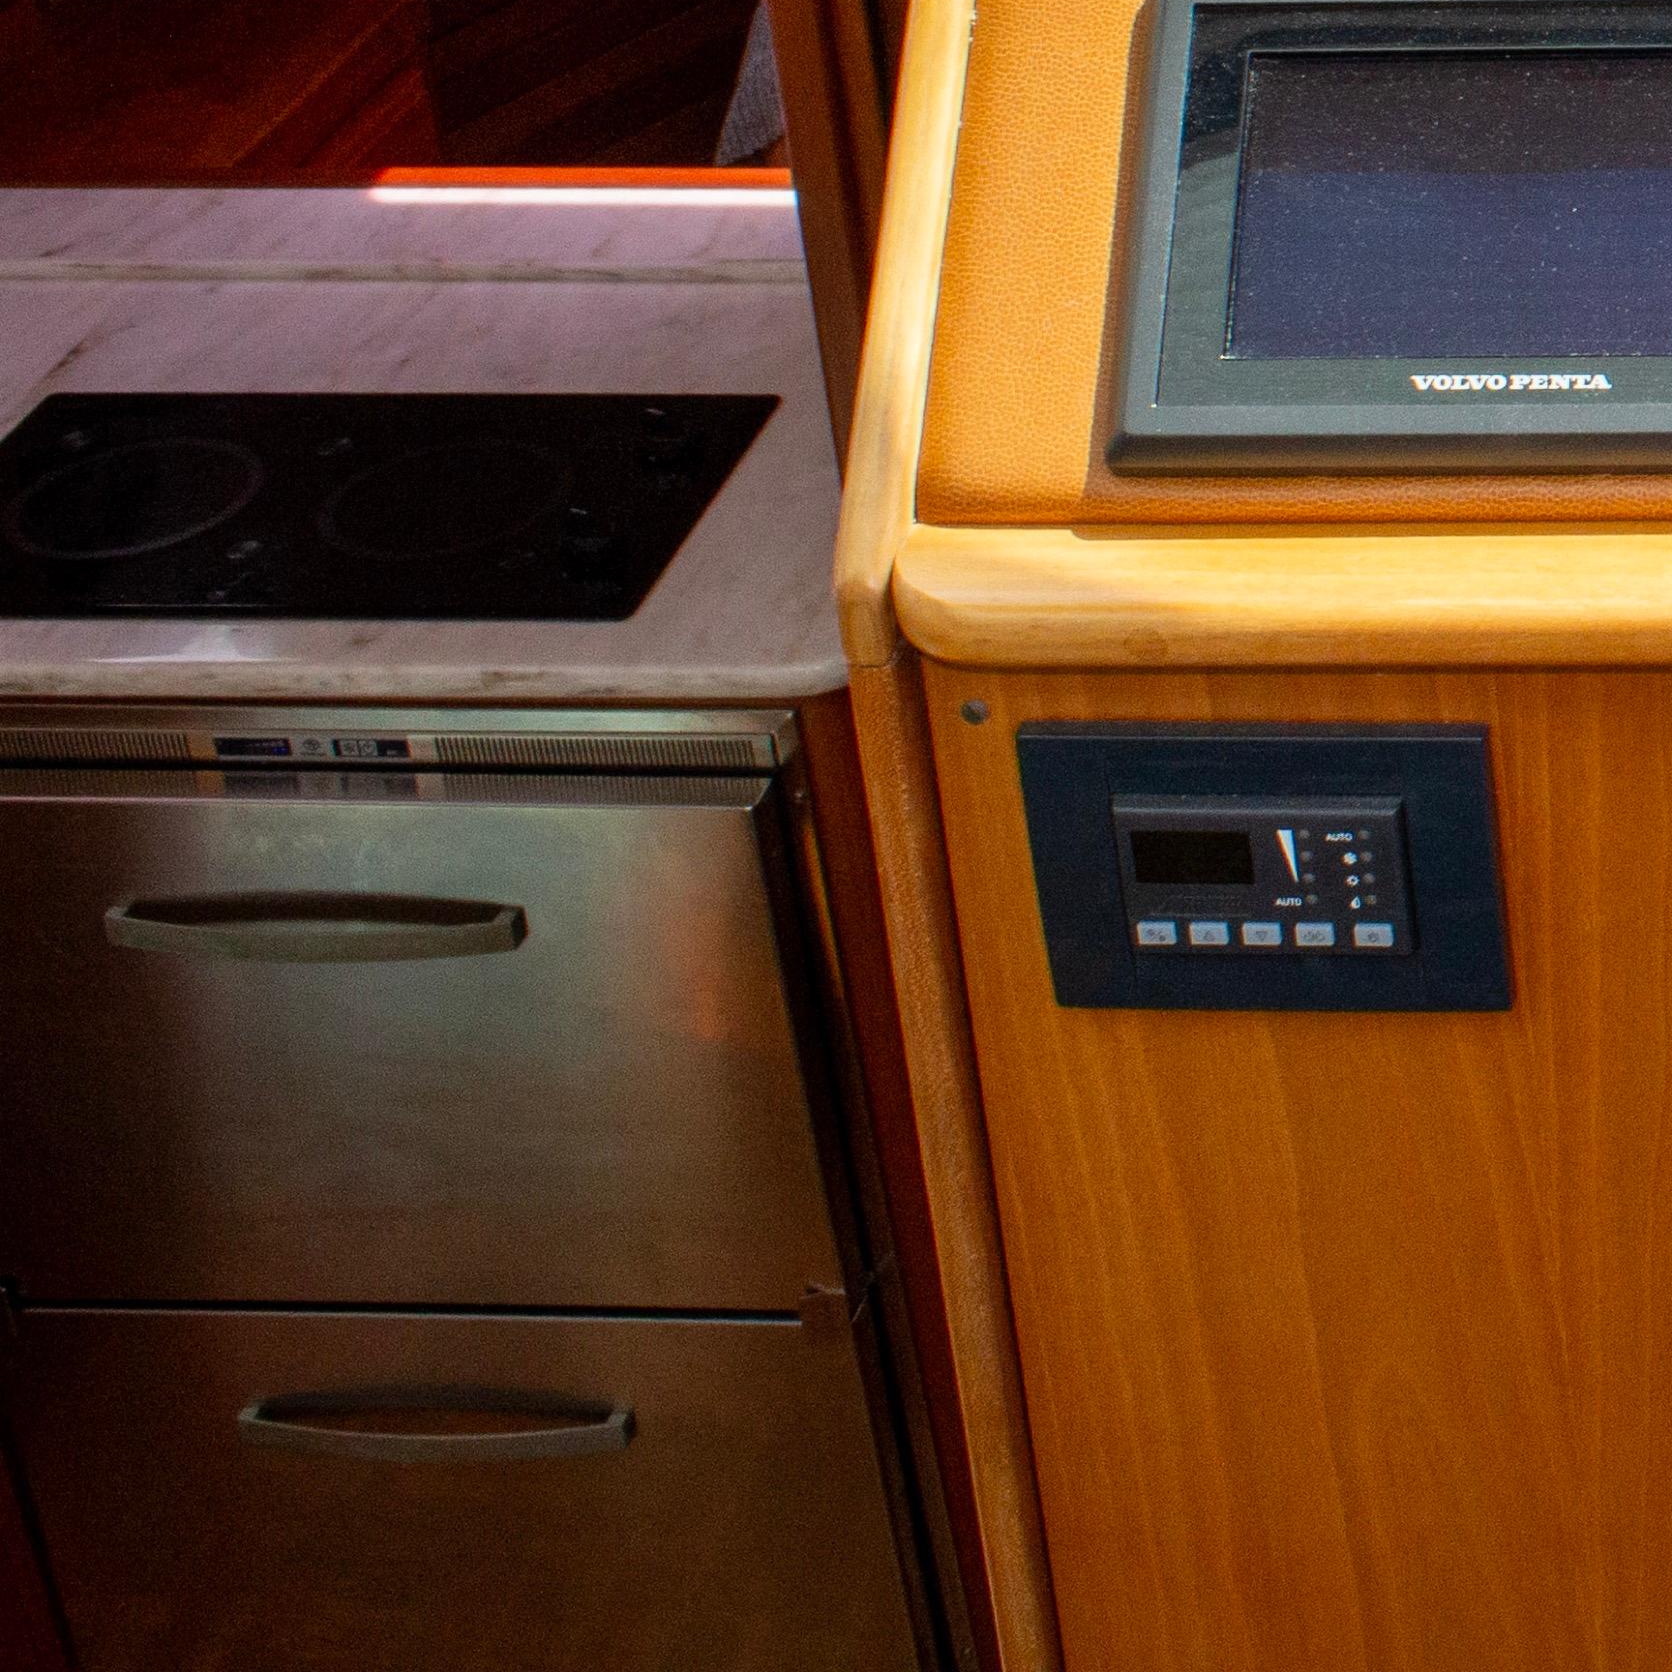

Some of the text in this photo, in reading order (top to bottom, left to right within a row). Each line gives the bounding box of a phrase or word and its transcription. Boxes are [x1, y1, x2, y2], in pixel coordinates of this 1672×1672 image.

[1411, 374, 1613, 391] VOLVO PENTA
[1326, 832, 1354, 841] AUTO
[1275, 897, 1303, 907] AUTO
